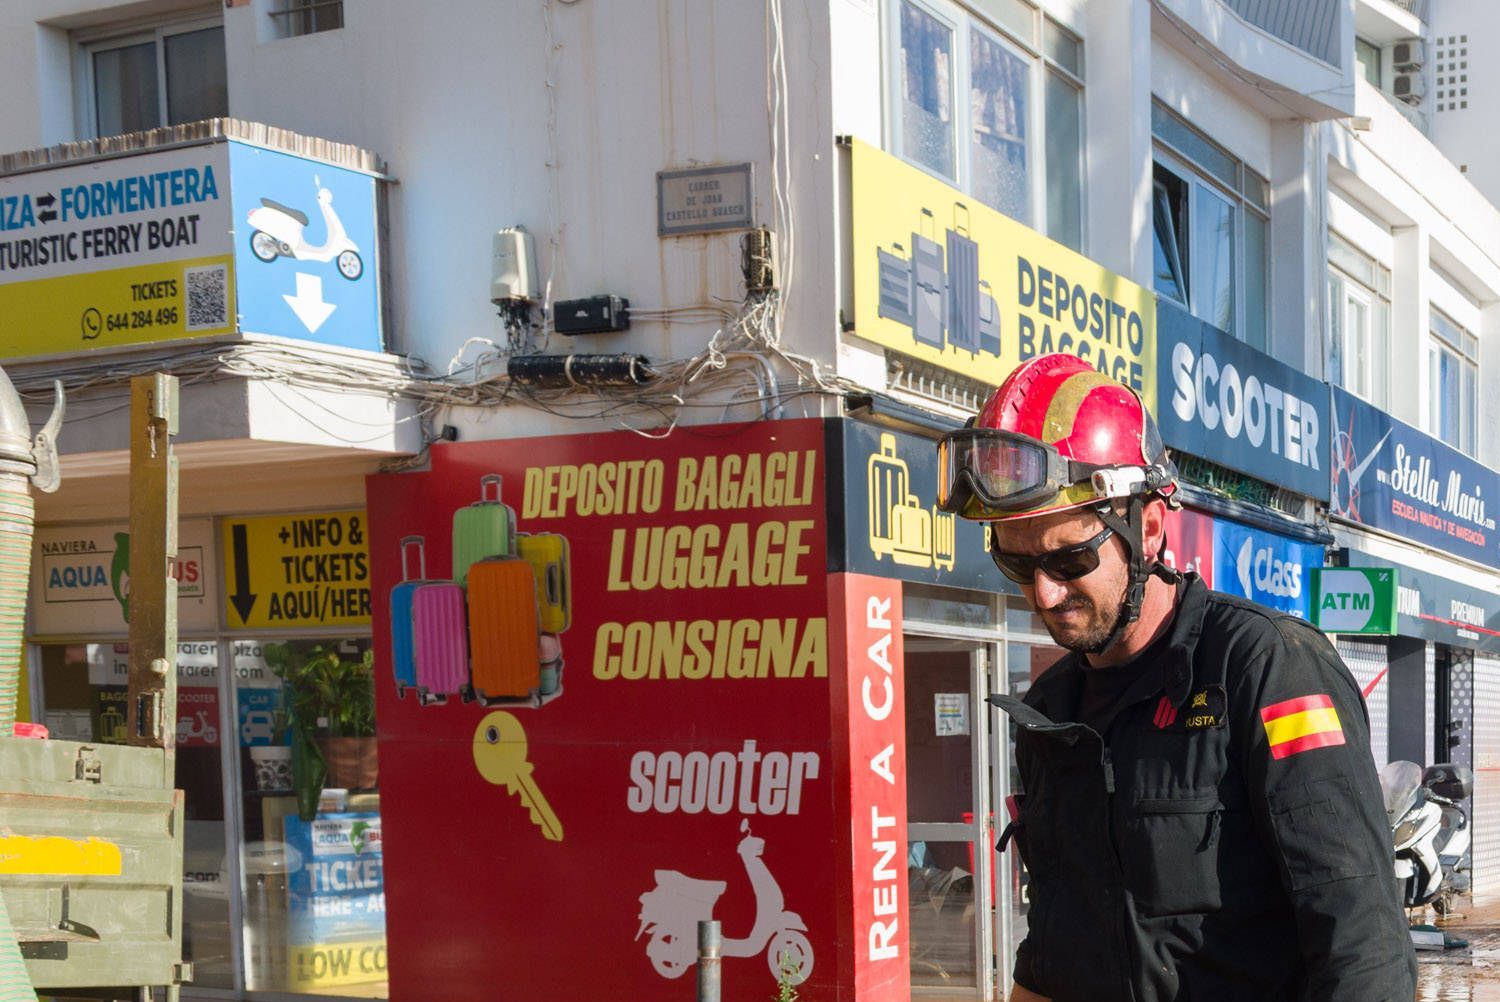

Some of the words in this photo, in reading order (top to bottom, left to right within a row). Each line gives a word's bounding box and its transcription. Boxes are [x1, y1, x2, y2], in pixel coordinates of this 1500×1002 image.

[0, 195, 35, 231] IZA
[61, 165, 219, 222] FORMENTERA
[686, 196, 697, 206] DE
[0, 232, 78, 271] TURISTIC
[82, 223, 142, 259] FERRY
[147, 214, 199, 250] BOAT
[131, 280, 177, 302] TICKETS
[1017, 254, 1144, 357] DEPOSITO
[106, 314, 129, 332] 644
[132, 310, 152, 329] 284
[155, 307, 178, 325] 496
[1171, 342, 1319, 471] SCOOTER
[521, 459, 663, 520] DEPOSITO
[675, 450, 817, 513] BAGAGLI
[1391, 498, 1418, 523] ESCUELA
[41, 540, 97, 553] NAVIERA
[348, 516, 363, 545] &
[281, 552, 368, 584] TICKETS
[606, 520, 815, 592] LUGGAGE
[49, 566, 108, 589] AQUA
[268, 584, 372, 622] AQUÍ/HER
[1321, 593, 1370, 610] ATM
[1450, 600, 1485, 628] PREMIUM
[592, 617, 828, 681] CONSIGNA
[861, 594, 893, 721] CAR
[100, 691, 129, 702] BAGG
[179, 693, 216, 703] COOTER
[1186, 716, 1215, 728] USTA
[626, 740, 820, 816] scooter
[869, 744, 895, 784] A
[318, 833, 348, 844] AQUA
[368, 829, 383, 842] BU
[305, 859, 383, 892] TICKE
[868, 805, 900, 962] RENT
[309, 894, 352, 917] HERE
[297, 947, 352, 982] LOW
